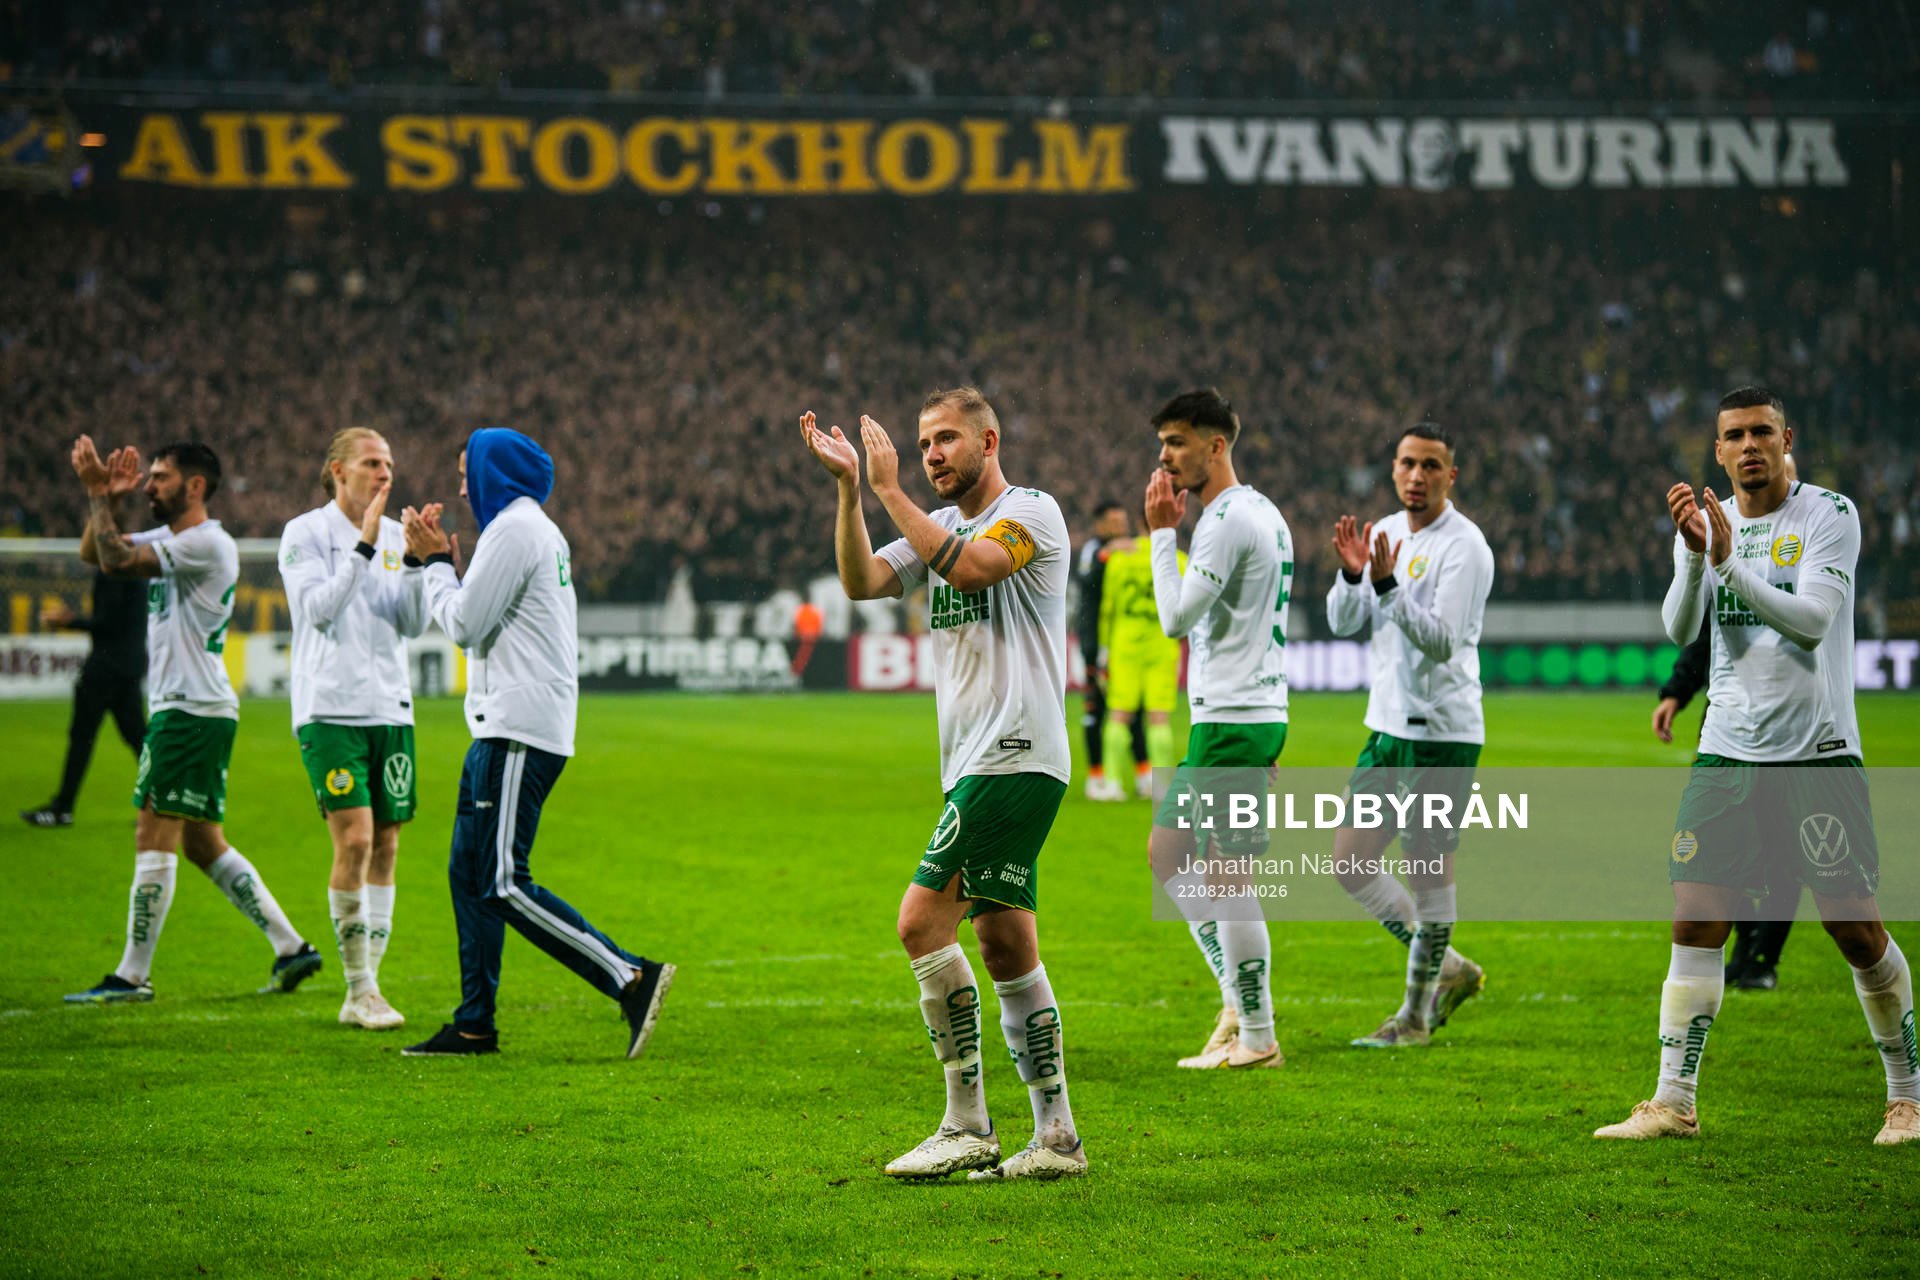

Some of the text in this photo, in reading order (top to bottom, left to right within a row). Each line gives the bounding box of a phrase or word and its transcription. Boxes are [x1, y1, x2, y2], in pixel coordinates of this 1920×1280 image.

[119, 113, 1133, 194] AIK STOCKHOLM
[1161, 116, 1849, 189] IVAN TURINA
